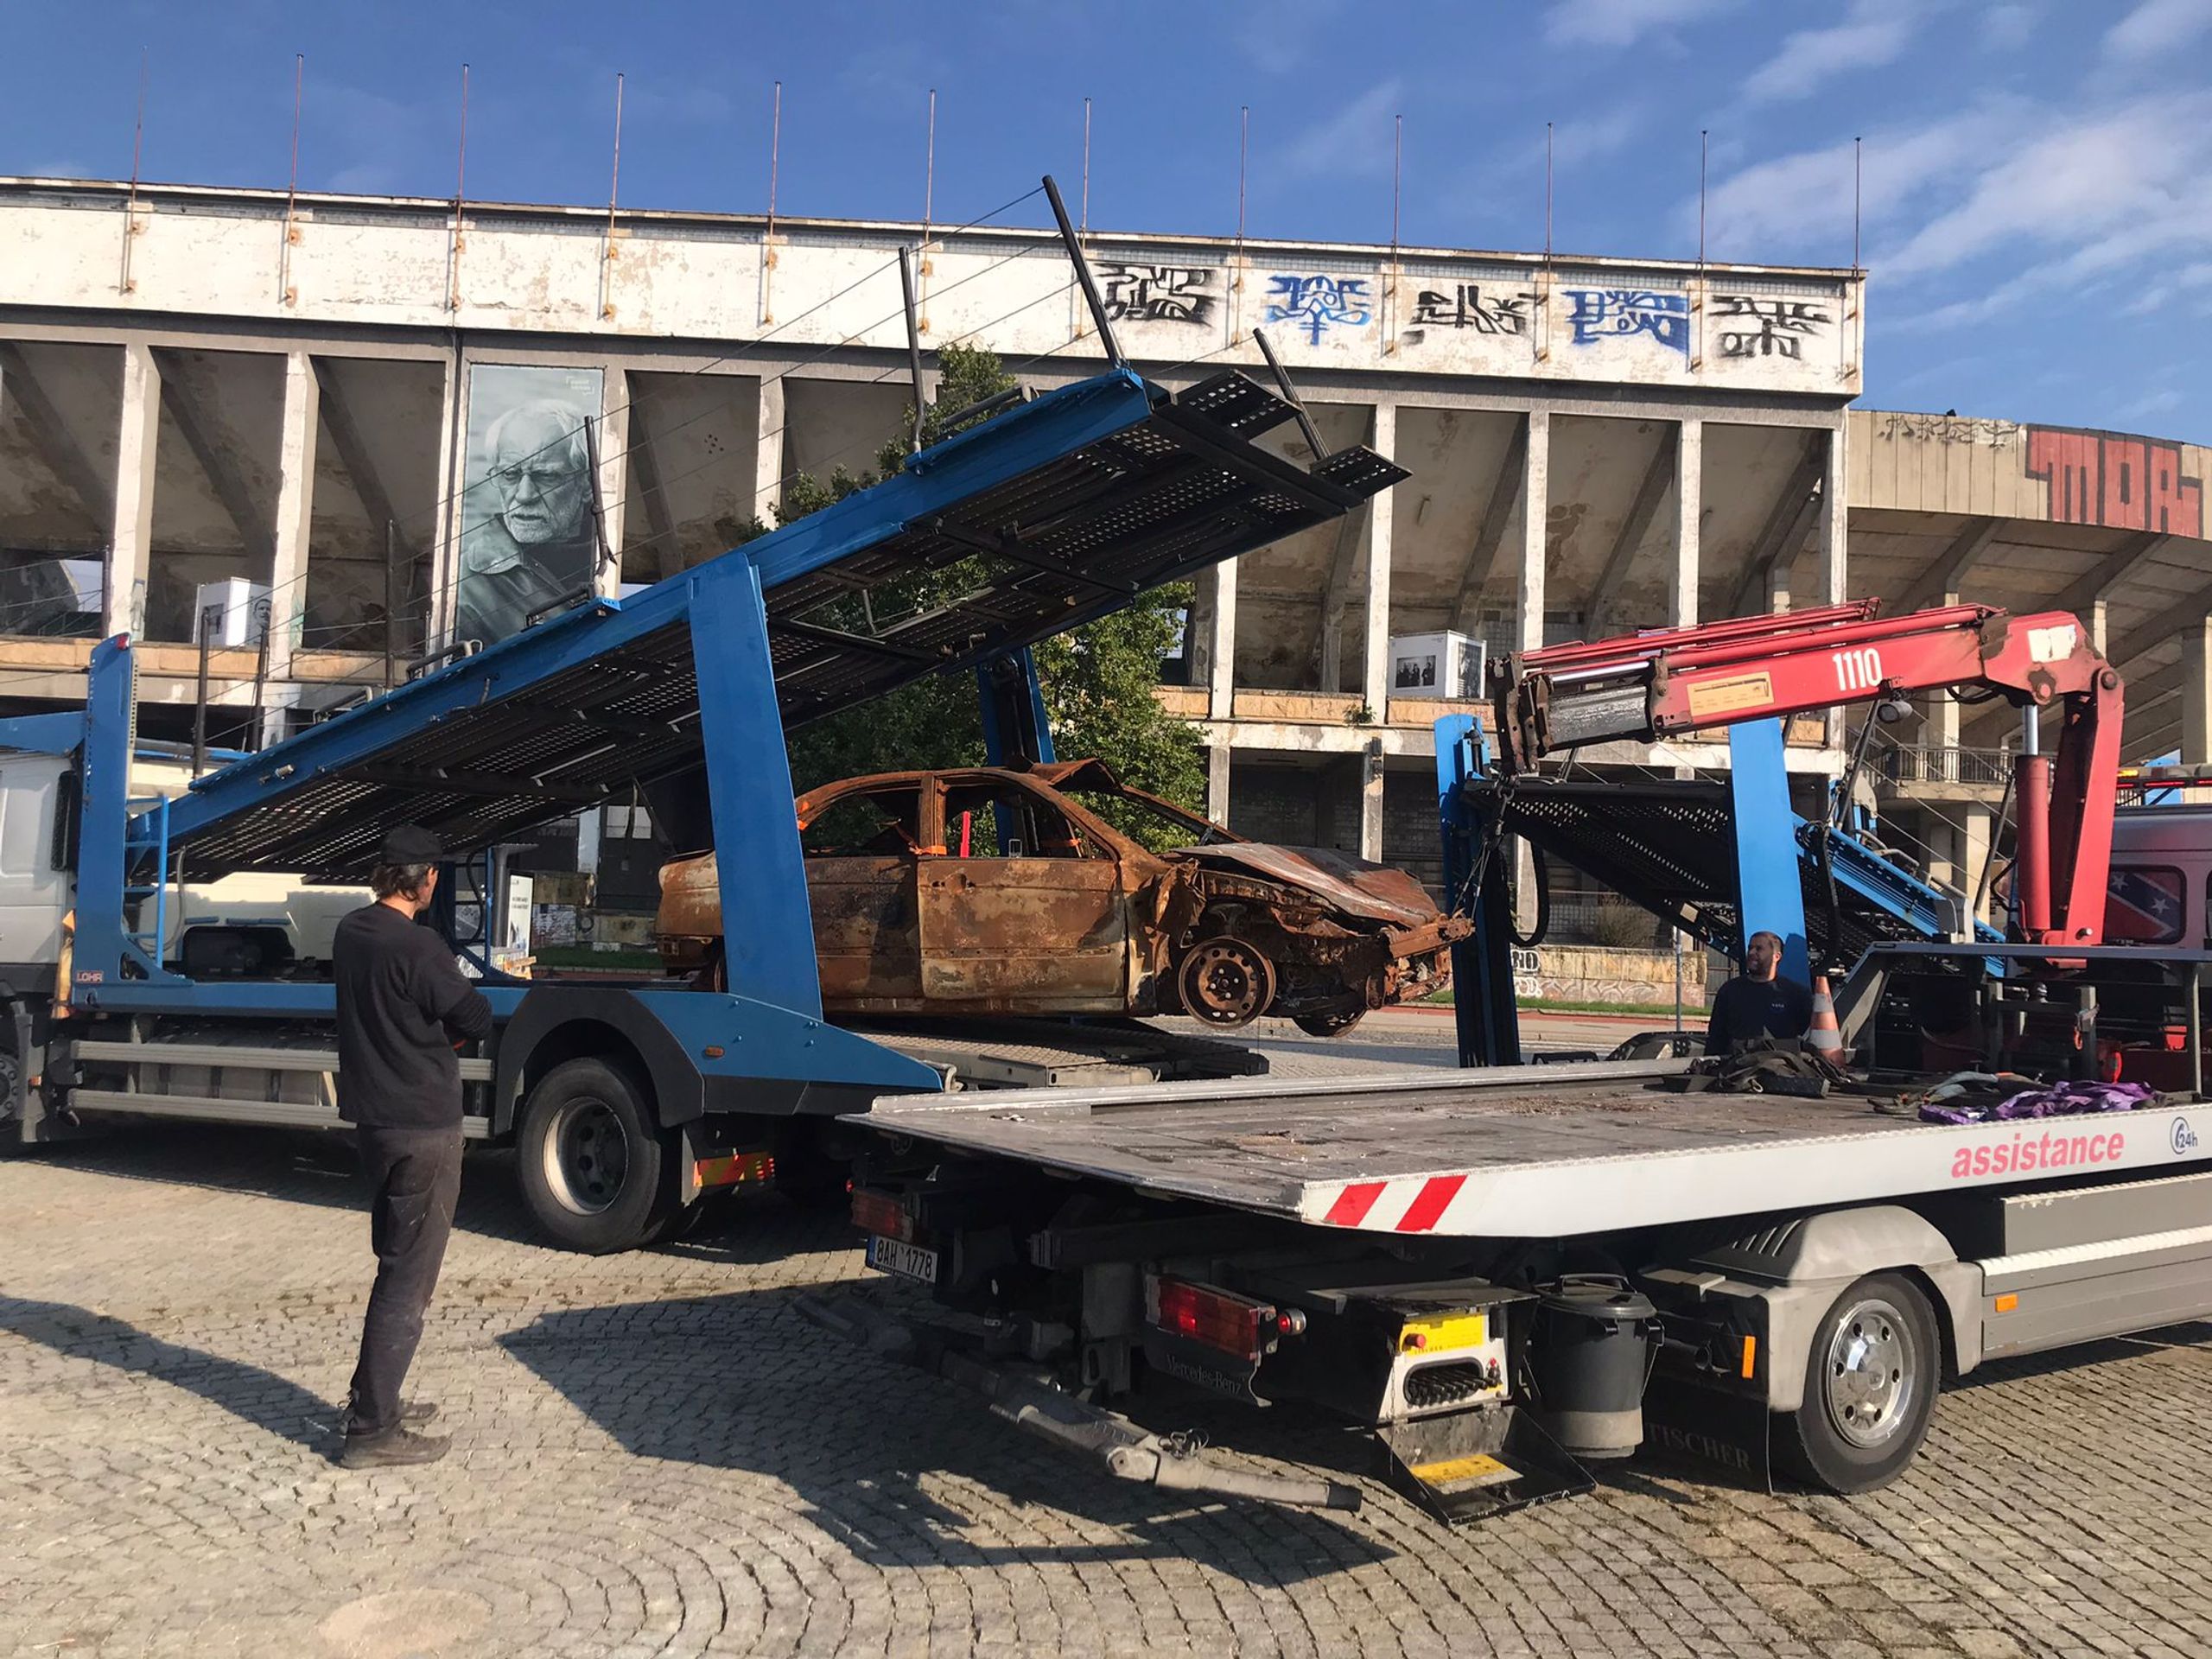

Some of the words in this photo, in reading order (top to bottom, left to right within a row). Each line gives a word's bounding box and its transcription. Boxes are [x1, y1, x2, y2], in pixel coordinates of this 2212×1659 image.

[1833, 648, 1883, 691] 1110
[1951, 1130, 2125, 1179] assistance
[2178, 1131, 2198, 1148] 24h
[876, 1239, 898, 1267] 8AH
[906, 1247, 932, 1279] 1778
[1166, 1354, 1243, 1395] Mercedes-Benz
